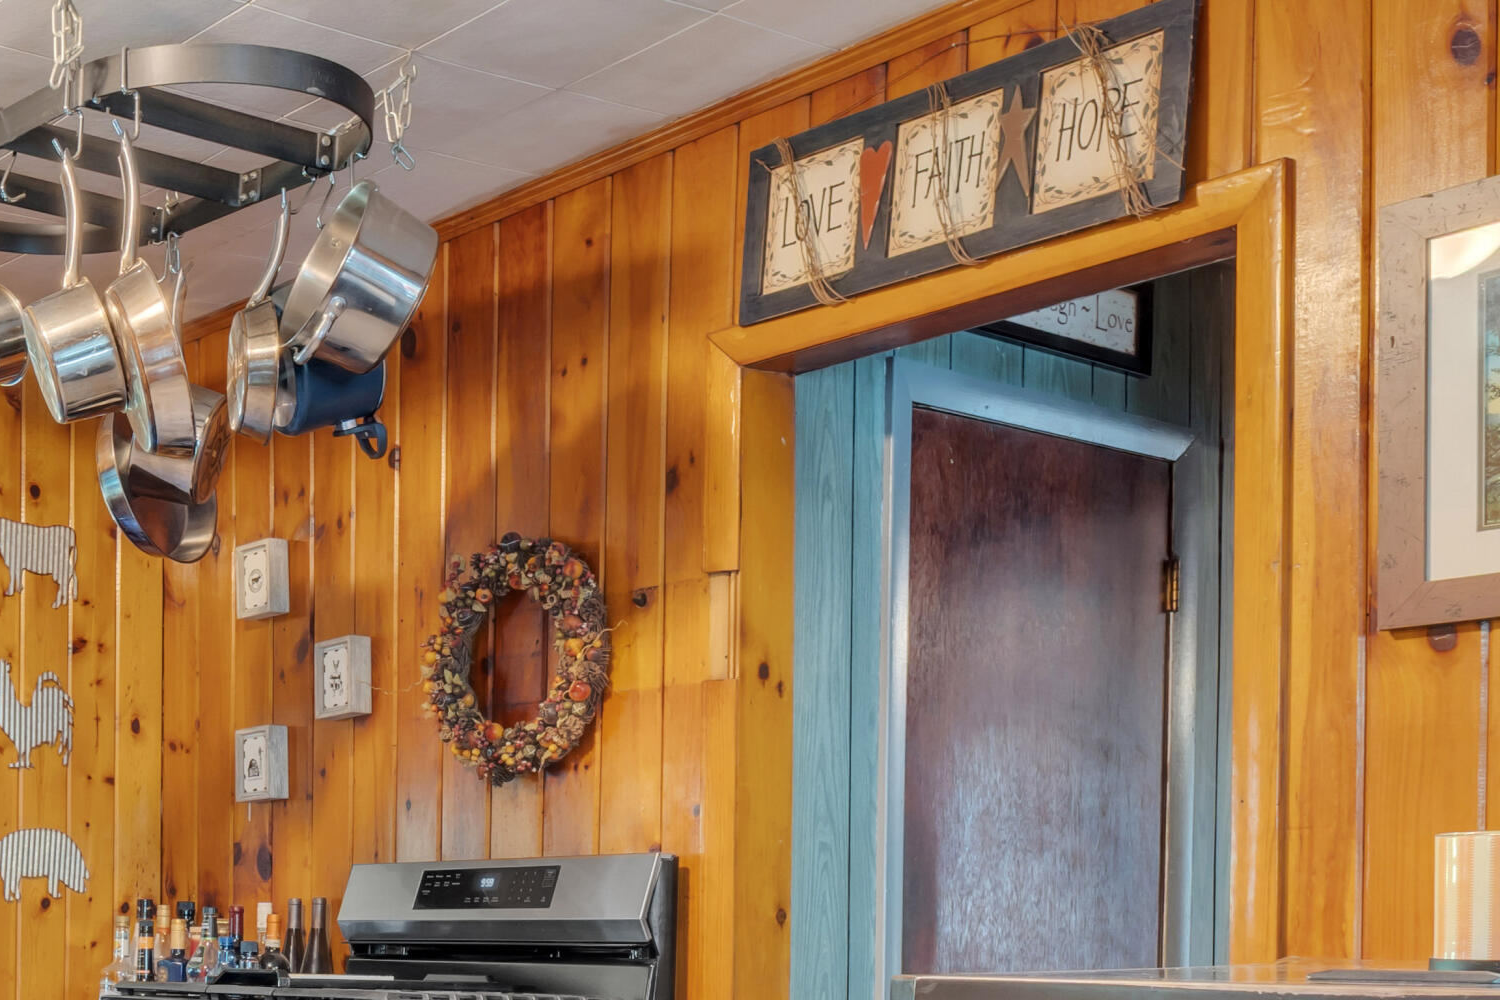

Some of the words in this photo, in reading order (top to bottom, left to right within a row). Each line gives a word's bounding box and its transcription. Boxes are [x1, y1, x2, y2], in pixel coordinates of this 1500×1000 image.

[1056, 78, 1144, 162] HOPE
[912, 131, 986, 208] FAITH
[781, 181, 845, 248] LOVE
[1096, 295, 1133, 332] Love
